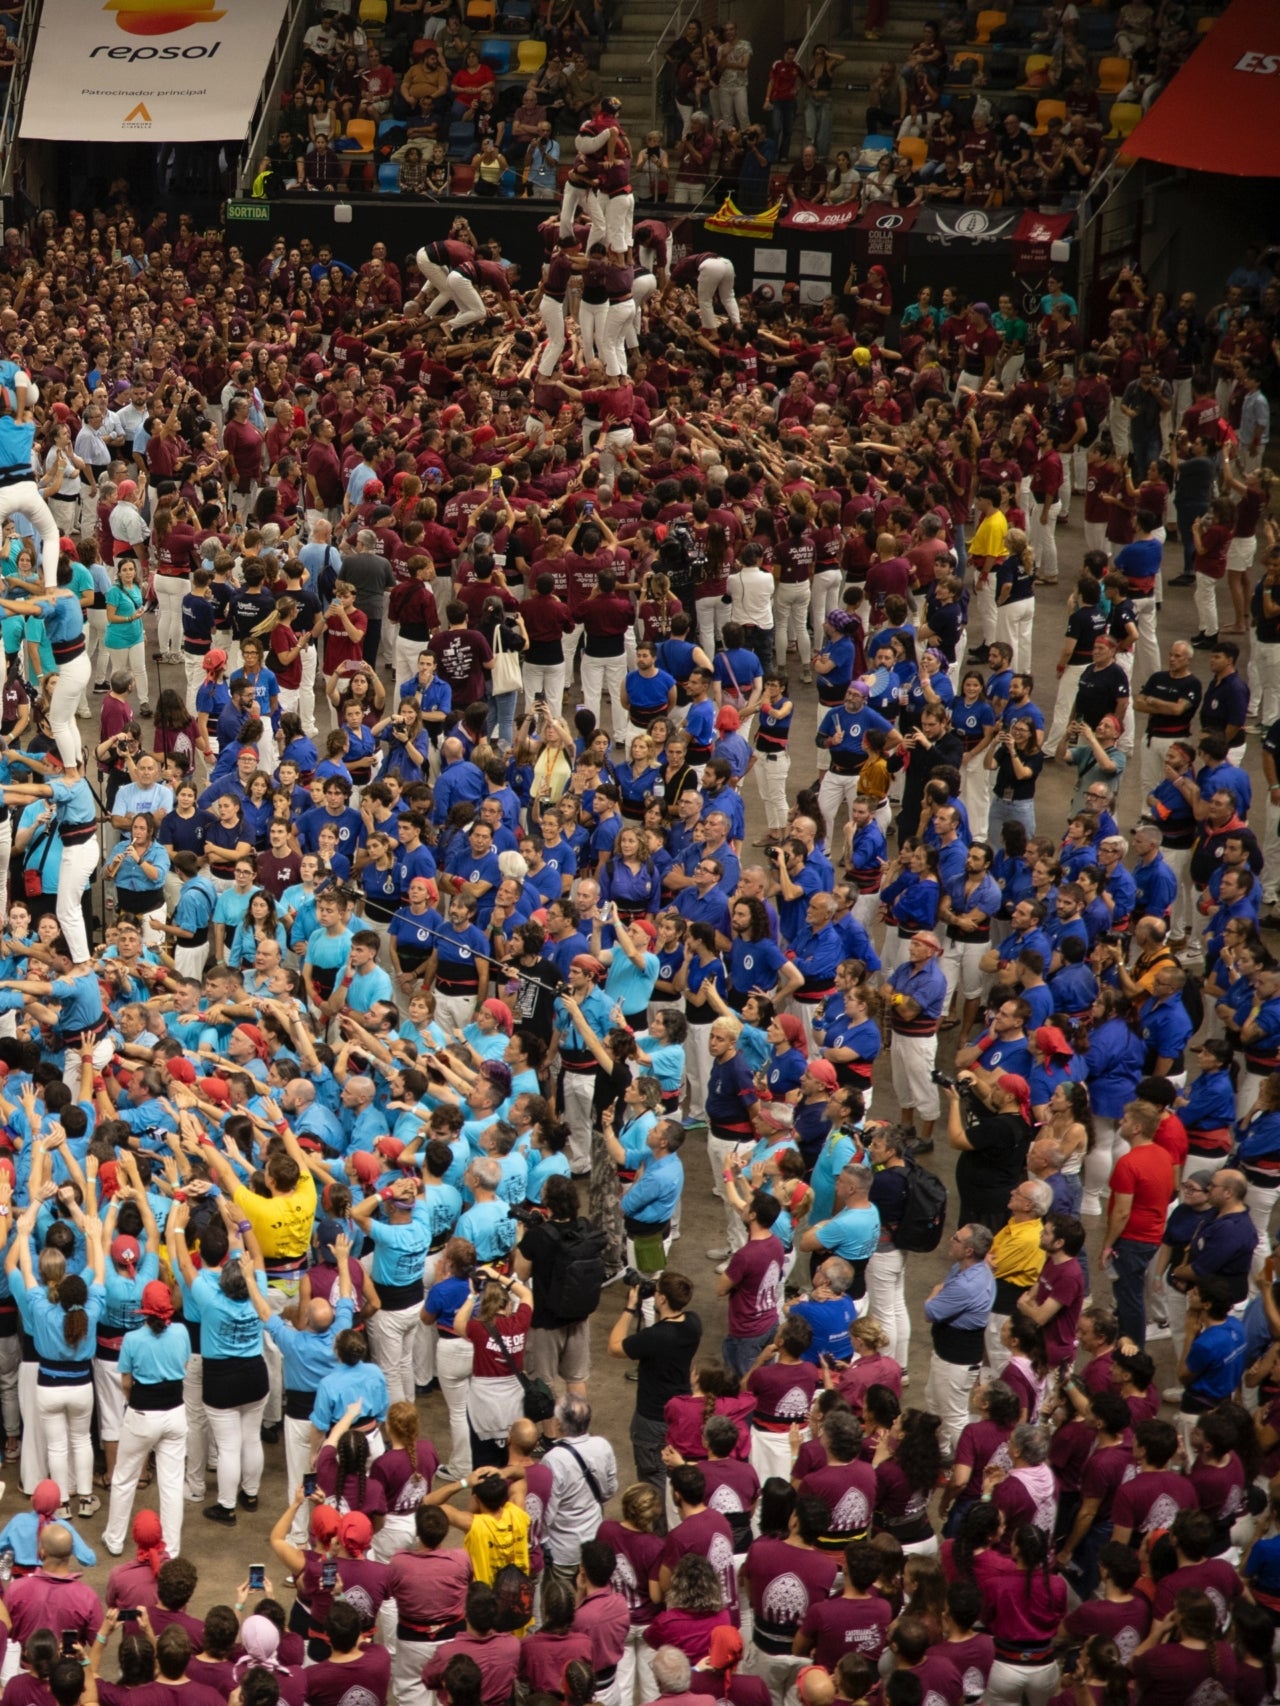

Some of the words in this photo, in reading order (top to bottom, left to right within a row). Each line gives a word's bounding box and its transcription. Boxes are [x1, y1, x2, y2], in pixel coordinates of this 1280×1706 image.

[89, 42, 221, 63] repsol
[157, 89, 207, 97] principal
[229, 207, 267, 217] SORTIDA
[824, 212, 852, 223] COLLA
[868, 230, 893, 239] COLLA
